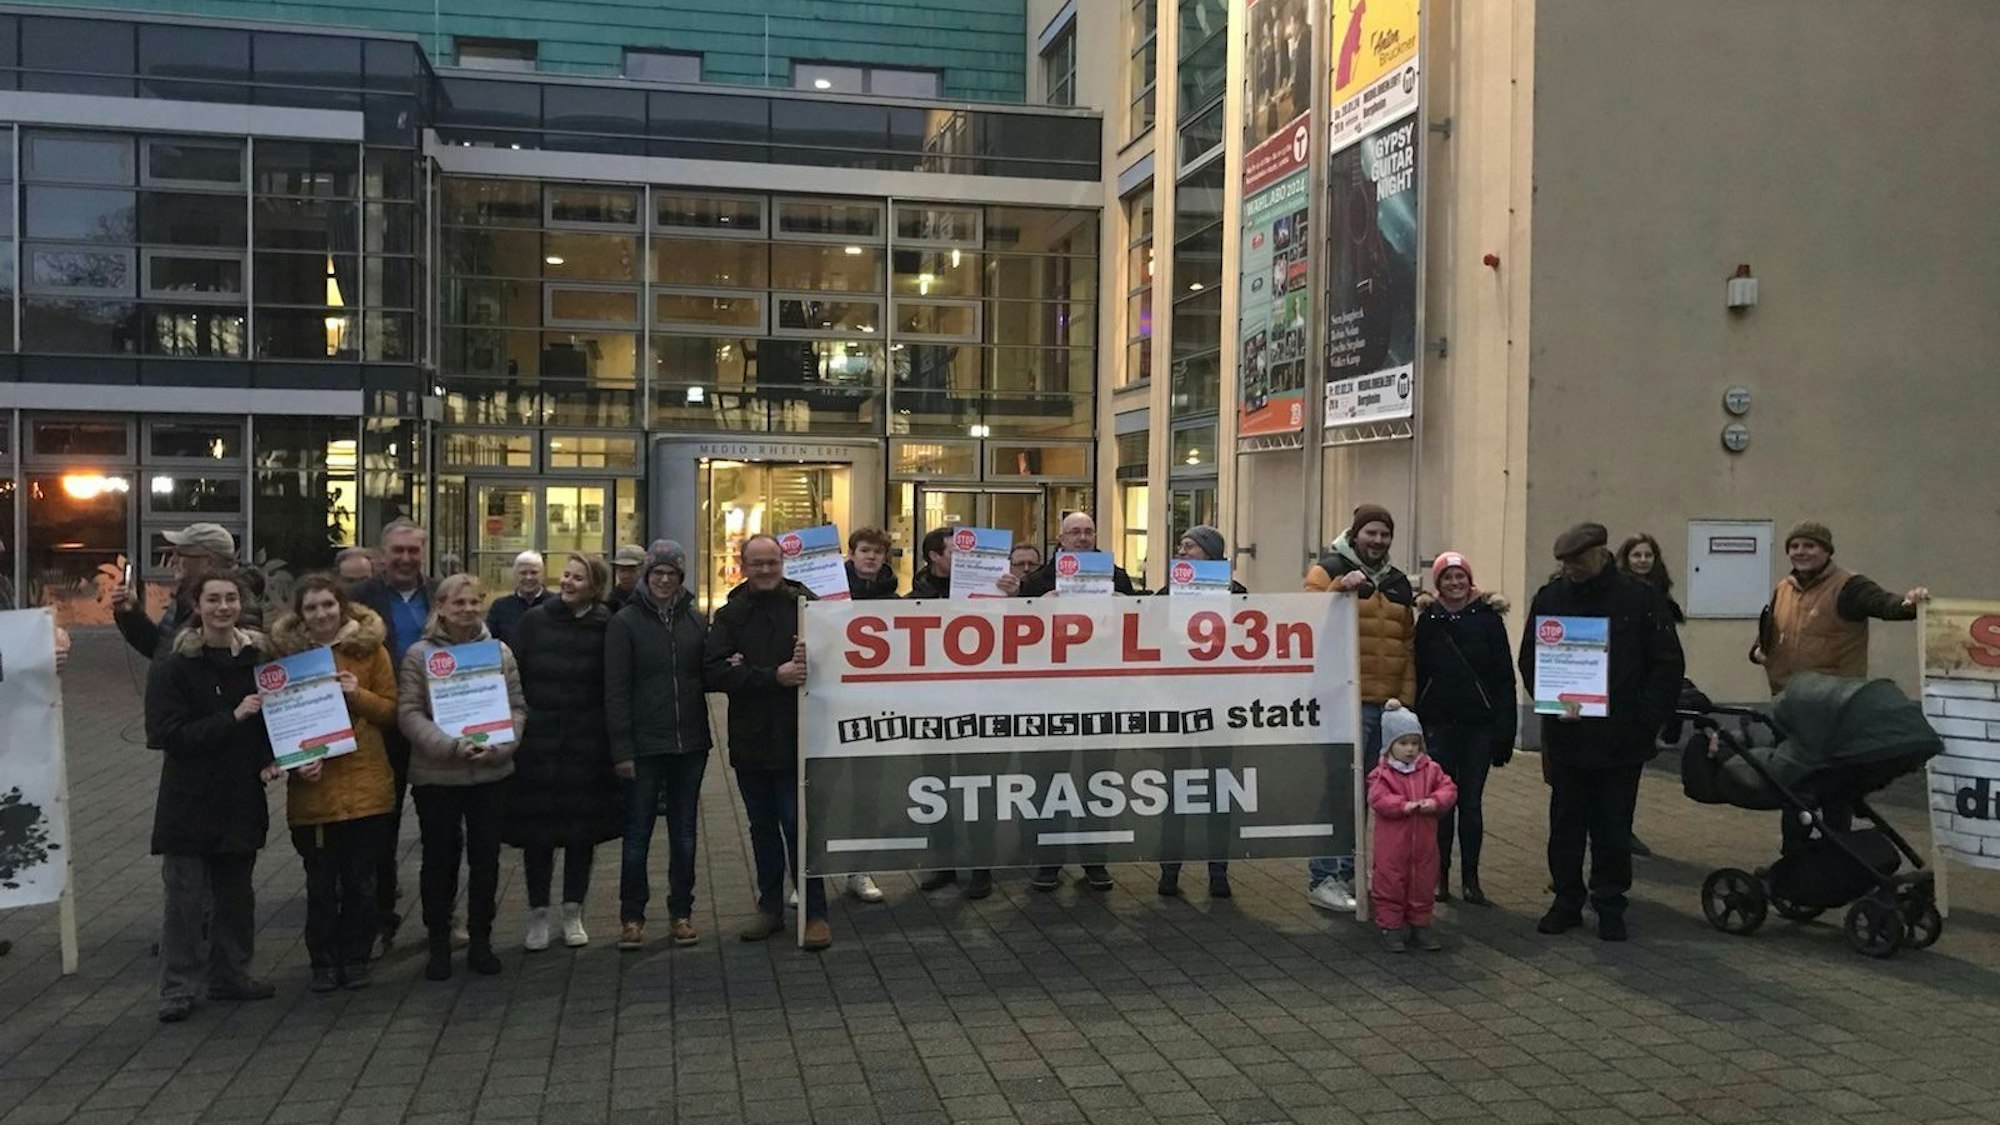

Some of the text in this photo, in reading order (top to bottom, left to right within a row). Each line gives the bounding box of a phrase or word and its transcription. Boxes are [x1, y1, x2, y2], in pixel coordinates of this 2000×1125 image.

[1375, 122, 1414, 158] GYPSY
[1370, 147, 1414, 182] GUITAR
[1287, 178, 1306, 197] 2024
[1376, 169, 1414, 201] NIGHT
[956, 535, 975, 545] STOP
[844, 609, 1315, 669] STOPP L 93n
[1540, 626, 1562, 636] STOP
[260, 669, 285, 687] STOP
[430, 658, 454, 670] STOP
[837, 697, 1321, 744] BÜRGERSTEIG statt
[907, 767, 1259, 824] STRASSEN
